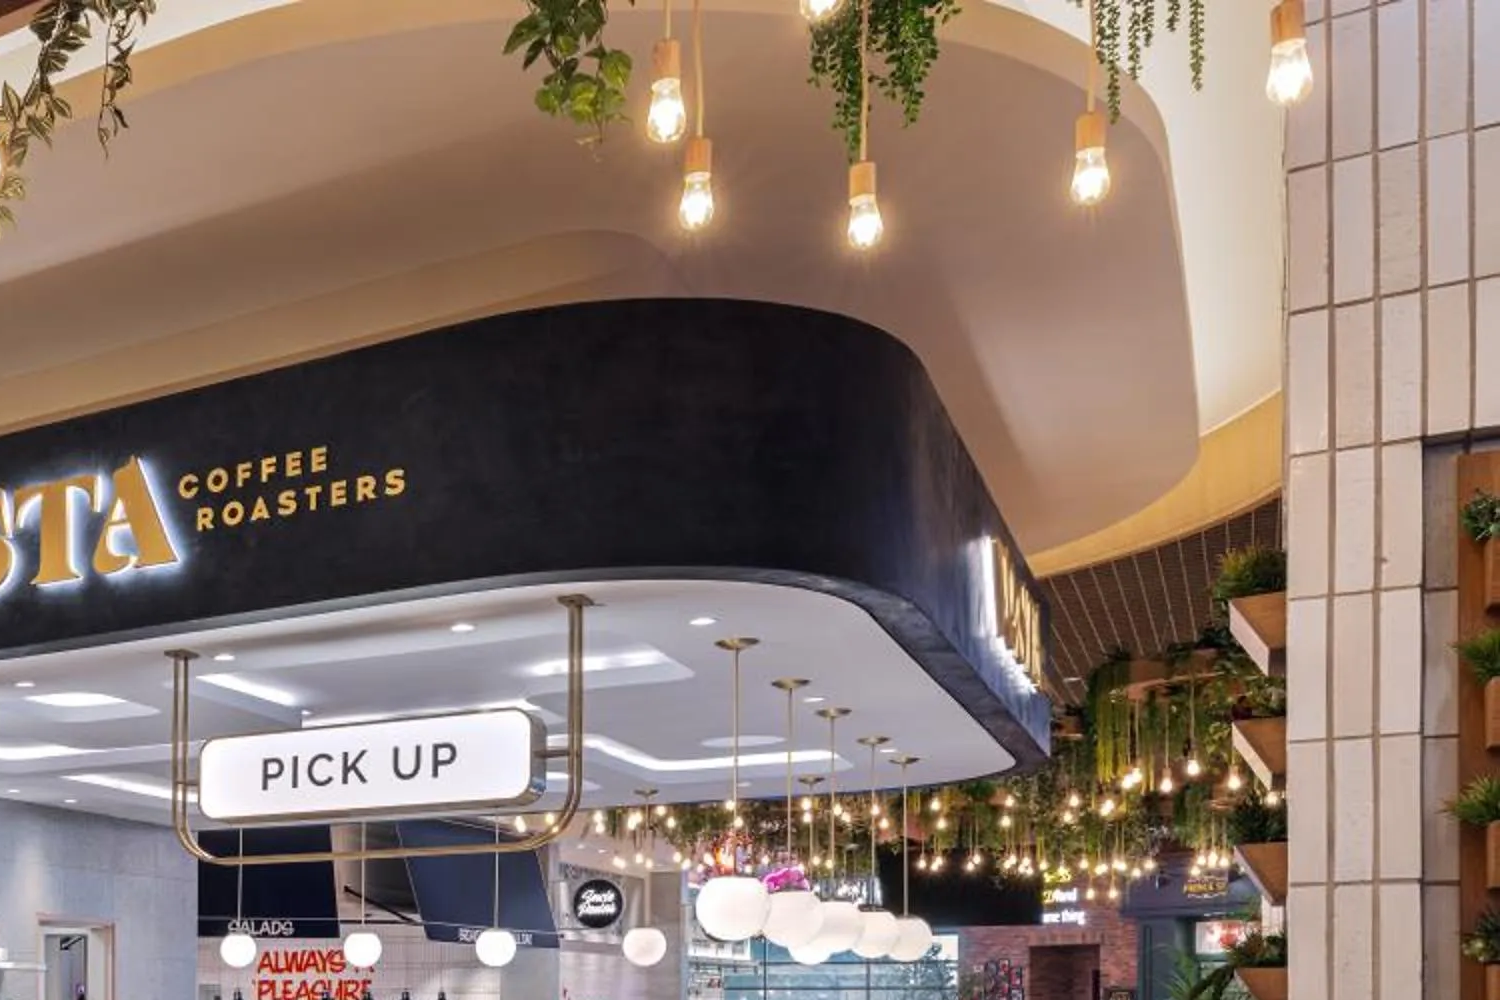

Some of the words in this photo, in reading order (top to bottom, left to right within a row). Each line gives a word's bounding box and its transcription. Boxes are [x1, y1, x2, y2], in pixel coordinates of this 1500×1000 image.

[178, 444, 328, 499] COFFEE
[196, 469, 406, 532] ROASTERS
[261, 749, 368, 791] PICK
[392, 742, 458, 781] UP
[228, 919, 295, 936] SALADS
[257, 949, 347, 974] ALWAYS
